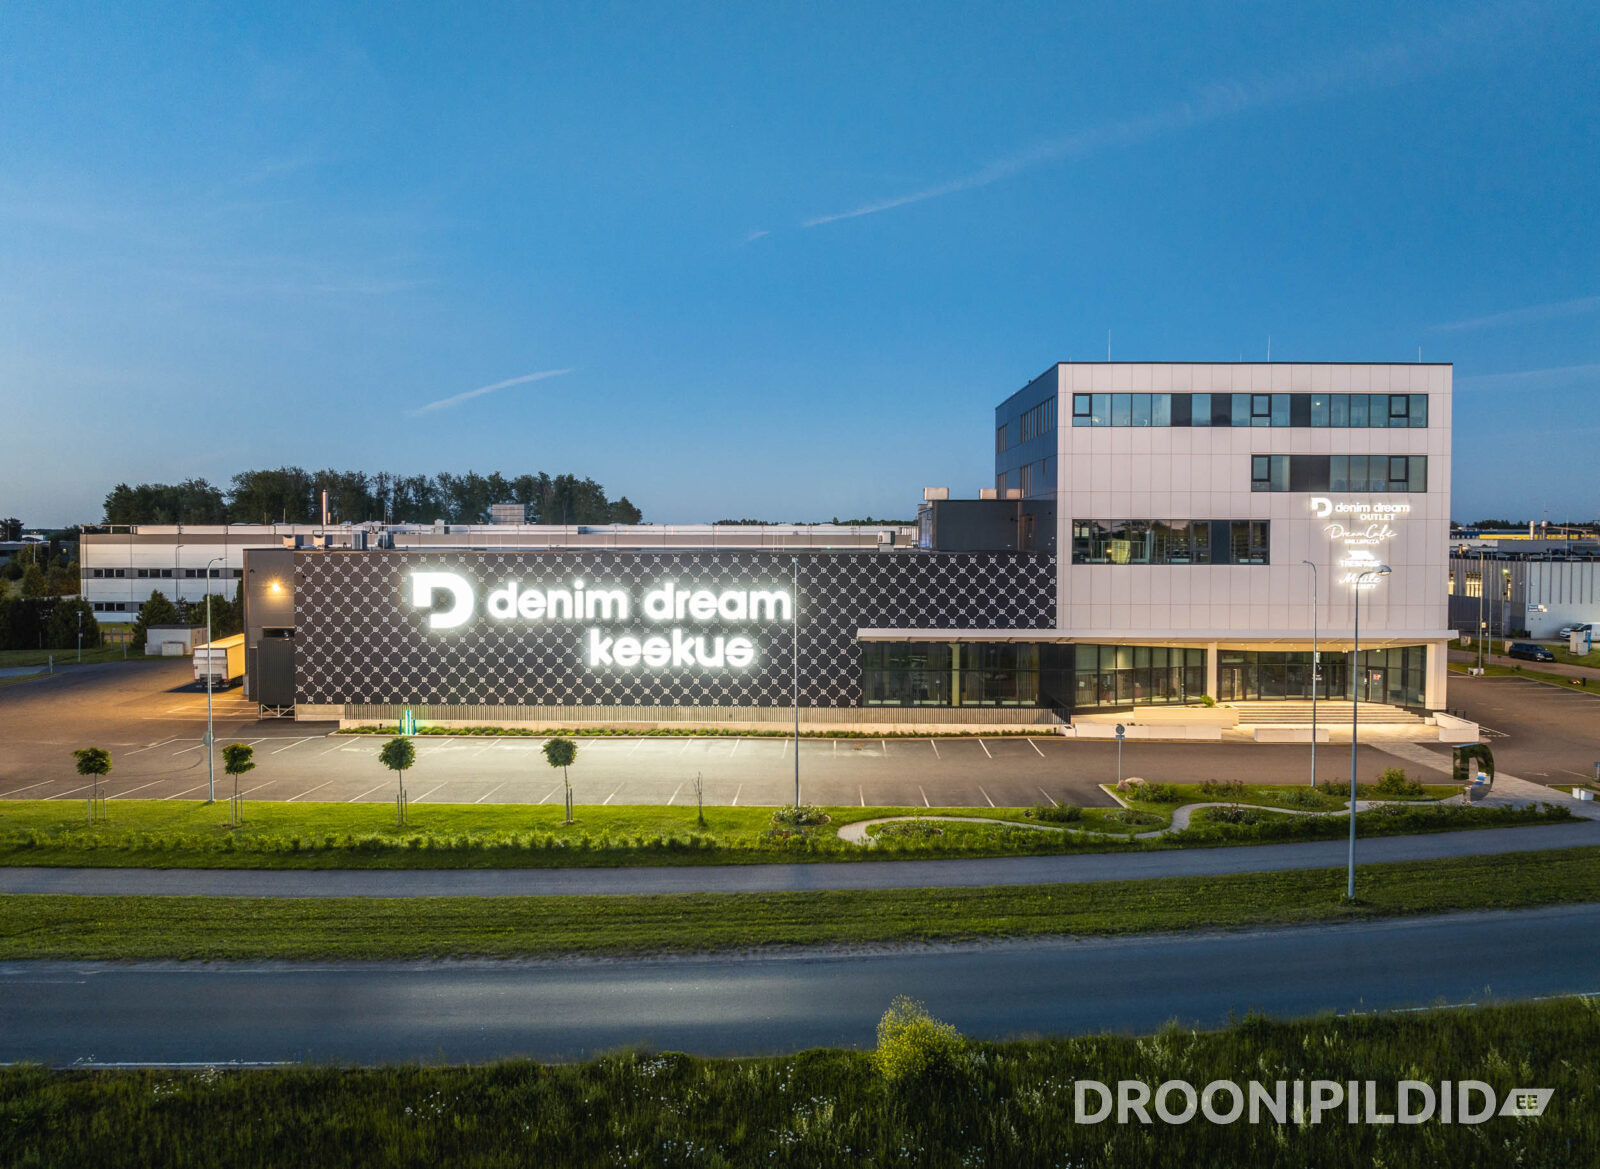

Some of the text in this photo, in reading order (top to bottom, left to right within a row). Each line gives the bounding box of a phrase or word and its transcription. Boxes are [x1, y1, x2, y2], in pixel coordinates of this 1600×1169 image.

[1335, 503, 1370, 512] denim
[1373, 503, 1410, 512] dream
[487, 580, 628, 619] denim
[644, 582, 791, 619] dream
[590, 629, 754, 667] keskus
